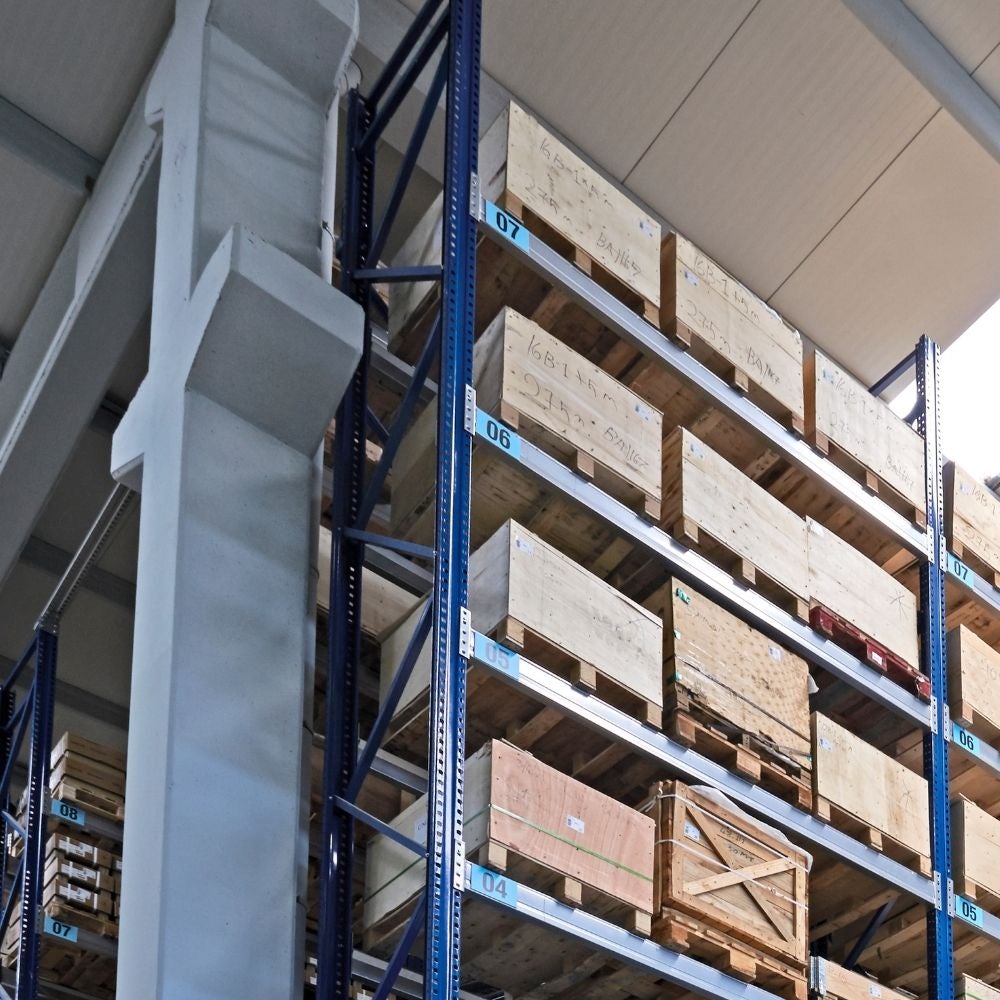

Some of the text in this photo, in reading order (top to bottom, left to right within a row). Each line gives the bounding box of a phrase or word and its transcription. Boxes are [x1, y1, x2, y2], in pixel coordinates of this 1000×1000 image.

[496, 210, 520, 239] 07
[487, 420, 511, 449] 06
[954, 561, 968, 581] 07
[486, 642, 510, 671] 05
[960, 731, 975, 751] 06
[60, 804, 77, 821] 08
[483, 871, 508, 899] 04
[962, 902, 977, 922] 05
[52, 921, 71, 937] 07
